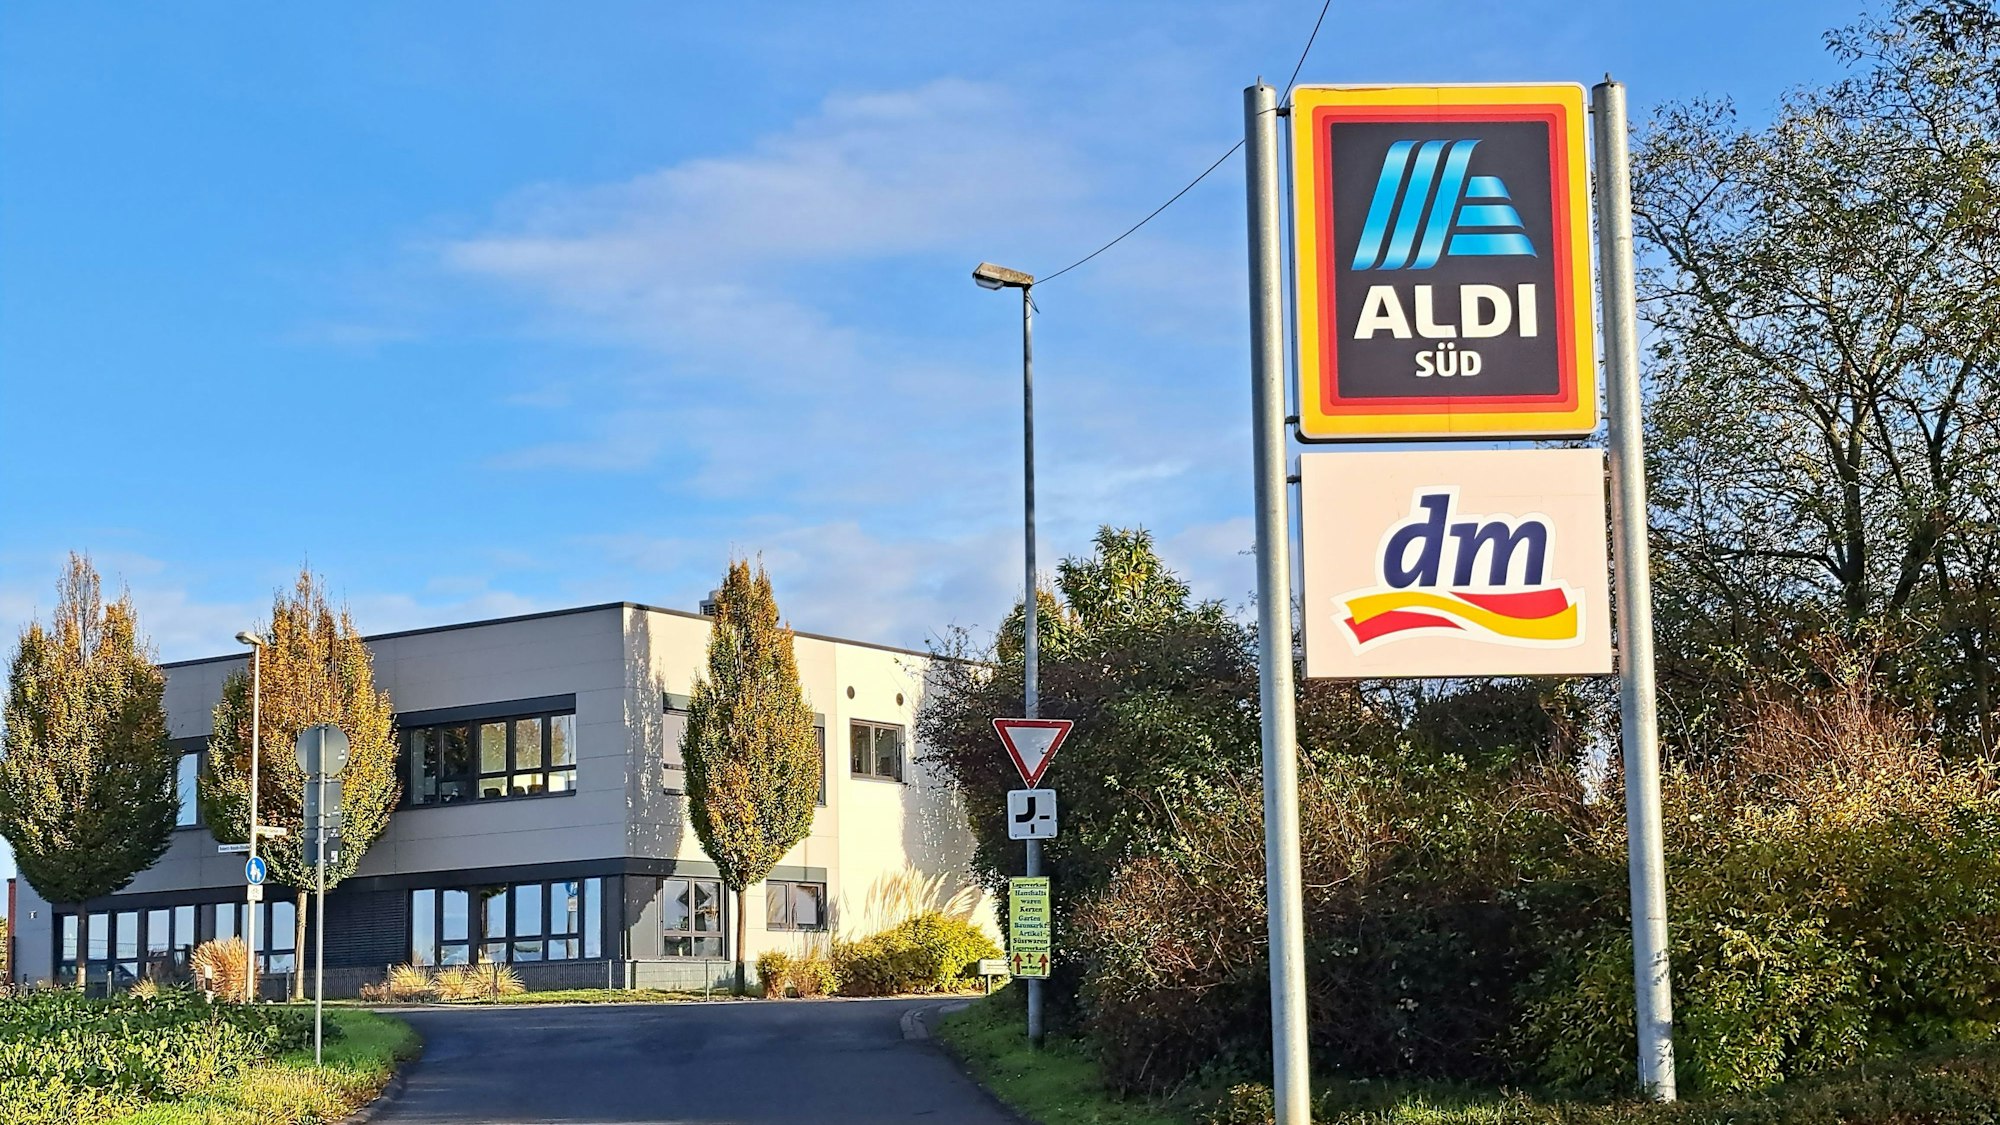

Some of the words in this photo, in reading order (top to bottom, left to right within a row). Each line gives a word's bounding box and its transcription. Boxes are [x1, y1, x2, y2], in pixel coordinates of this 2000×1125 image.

[1354, 284, 1538, 339] ALDI
[1415, 342, 1482, 377] SÜD
[1383, 494, 1547, 589] dm
